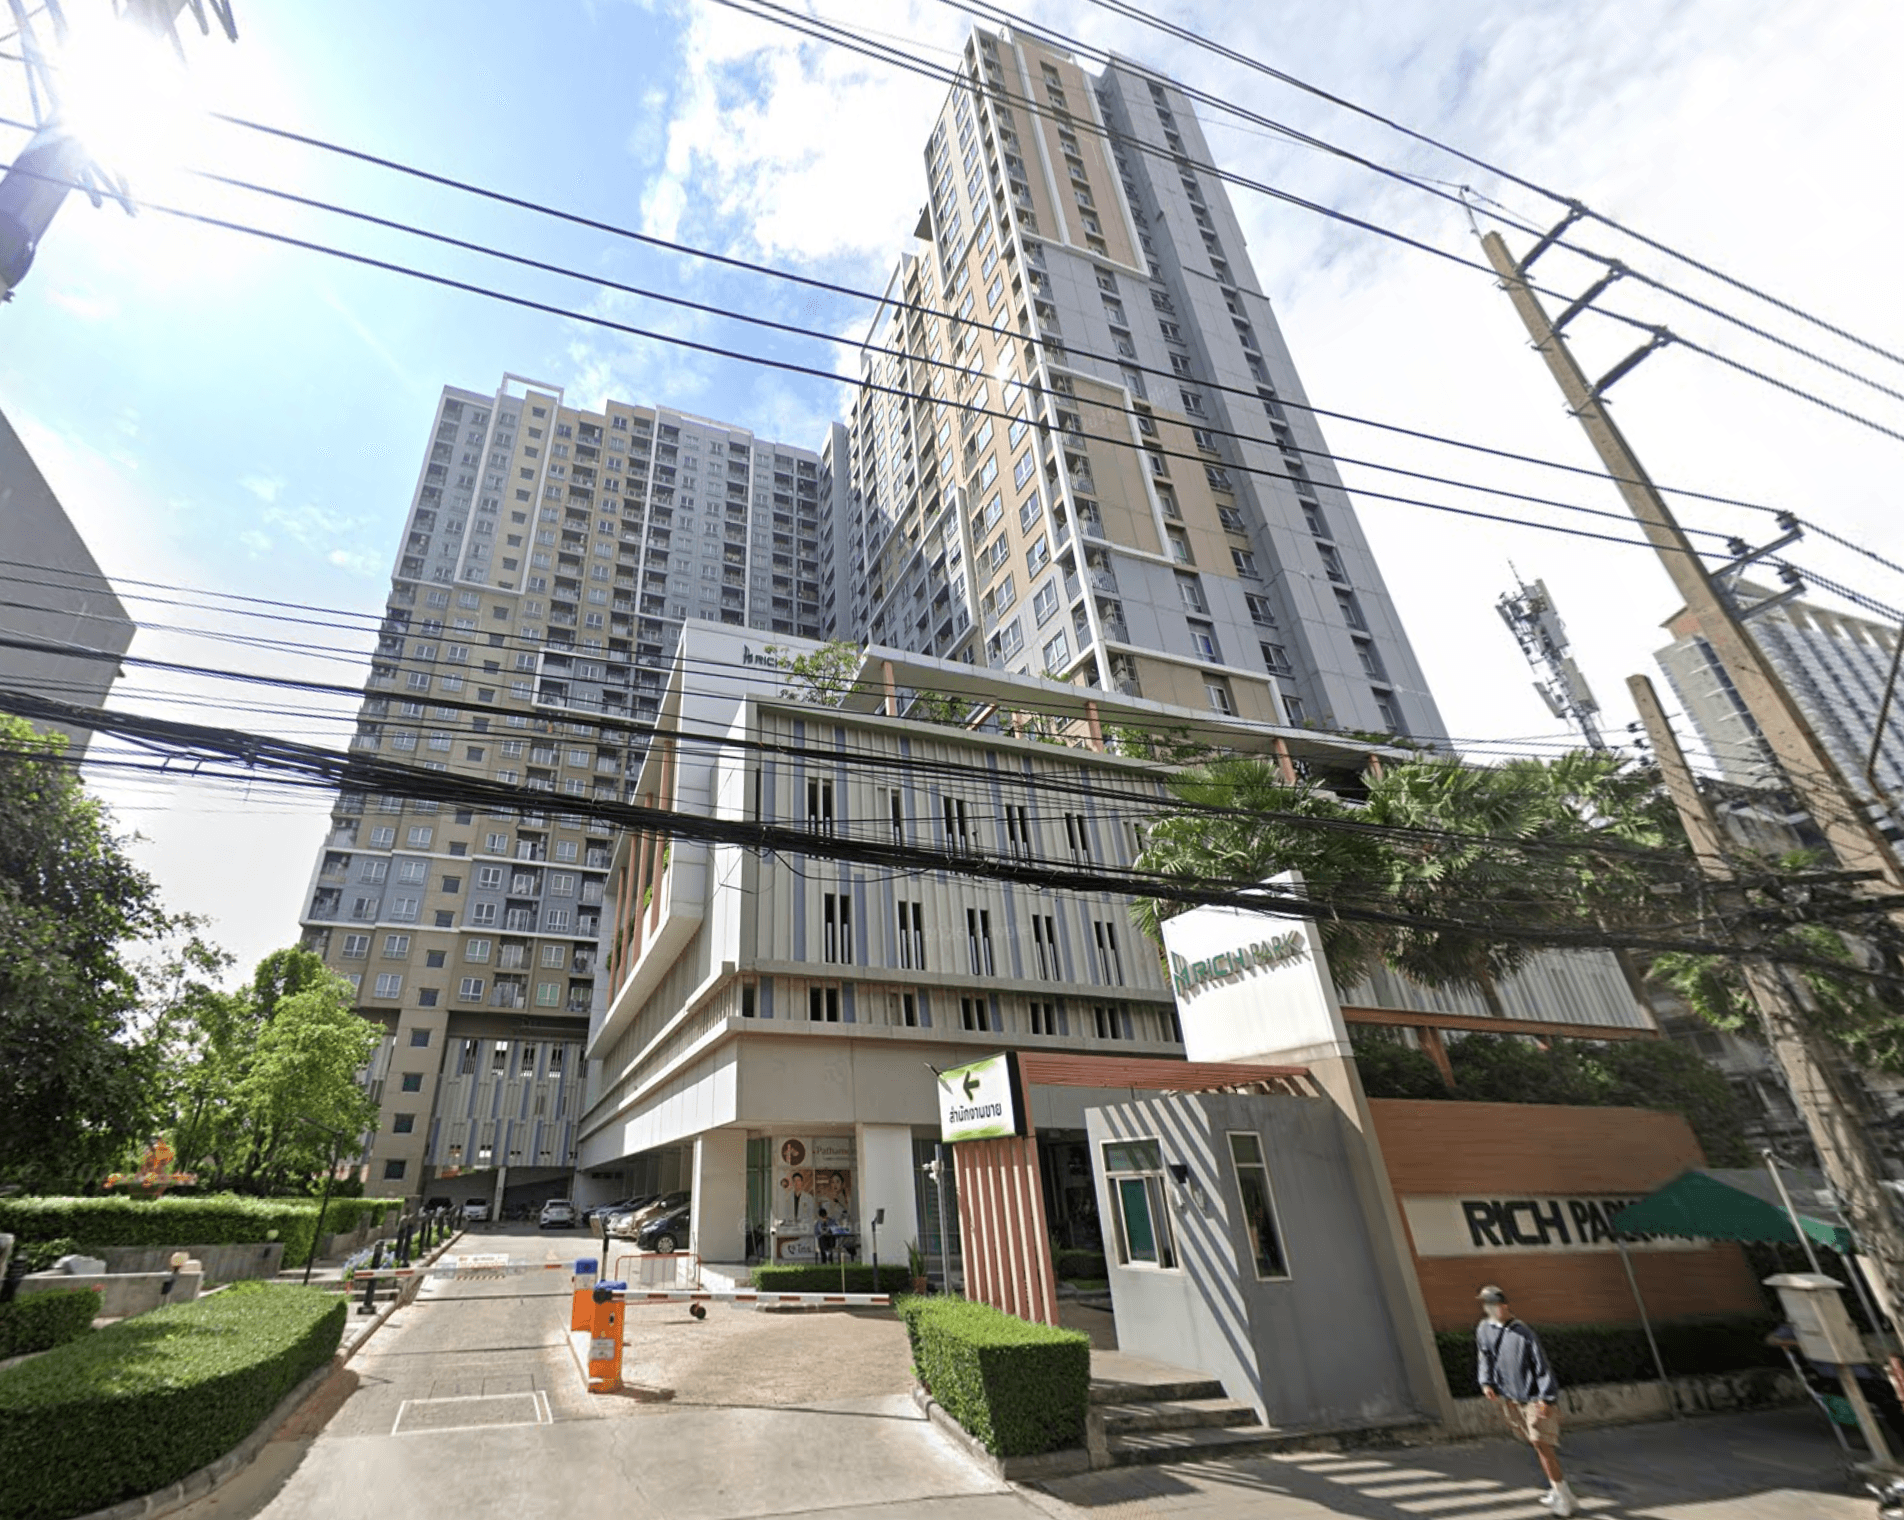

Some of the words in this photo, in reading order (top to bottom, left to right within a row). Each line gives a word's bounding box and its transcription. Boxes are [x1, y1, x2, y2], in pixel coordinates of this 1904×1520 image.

[1191, 947, 1247, 983] RICH
[1249, 930, 1306, 965] PARK
[949, 1102, 1002, 1123] สำนักงานขาย
[1462, 1201, 1571, 1246] RICH
